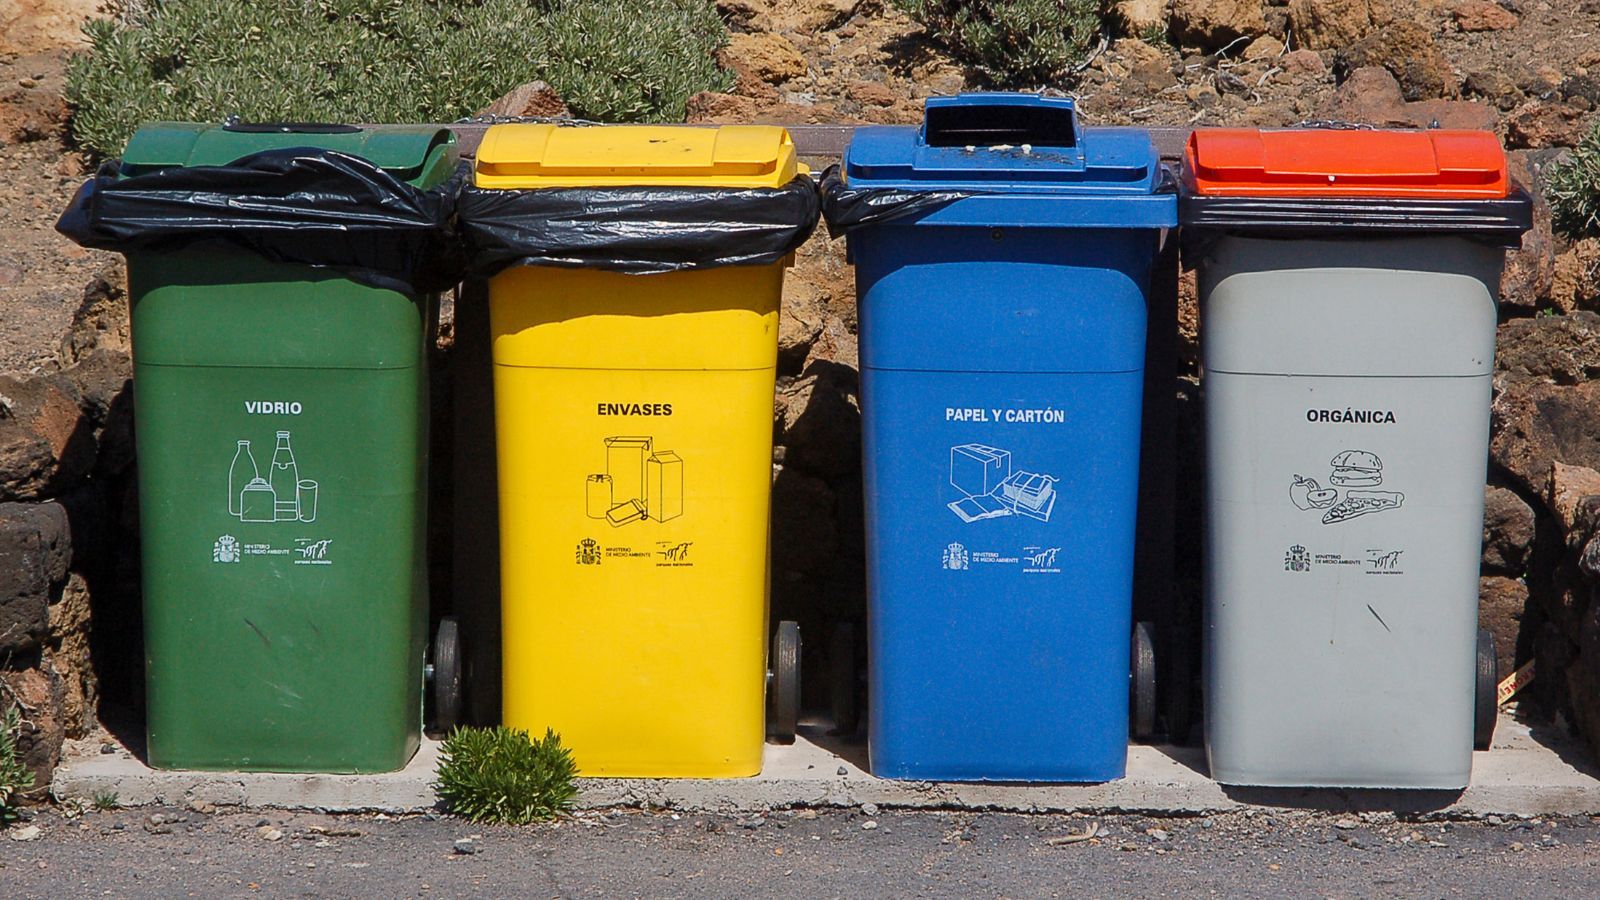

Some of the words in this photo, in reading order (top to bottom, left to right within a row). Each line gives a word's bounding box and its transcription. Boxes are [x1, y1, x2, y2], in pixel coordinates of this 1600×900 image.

[244, 401, 302, 415] VIDRIO
[597, 403, 673, 416] ENVASES
[945, 407, 989, 422] PAPEL
[992, 409, 1002, 422] Y
[1005, 406, 1065, 423] CARTÓN
[1306, 407, 1396, 424] ORGÁNICA
